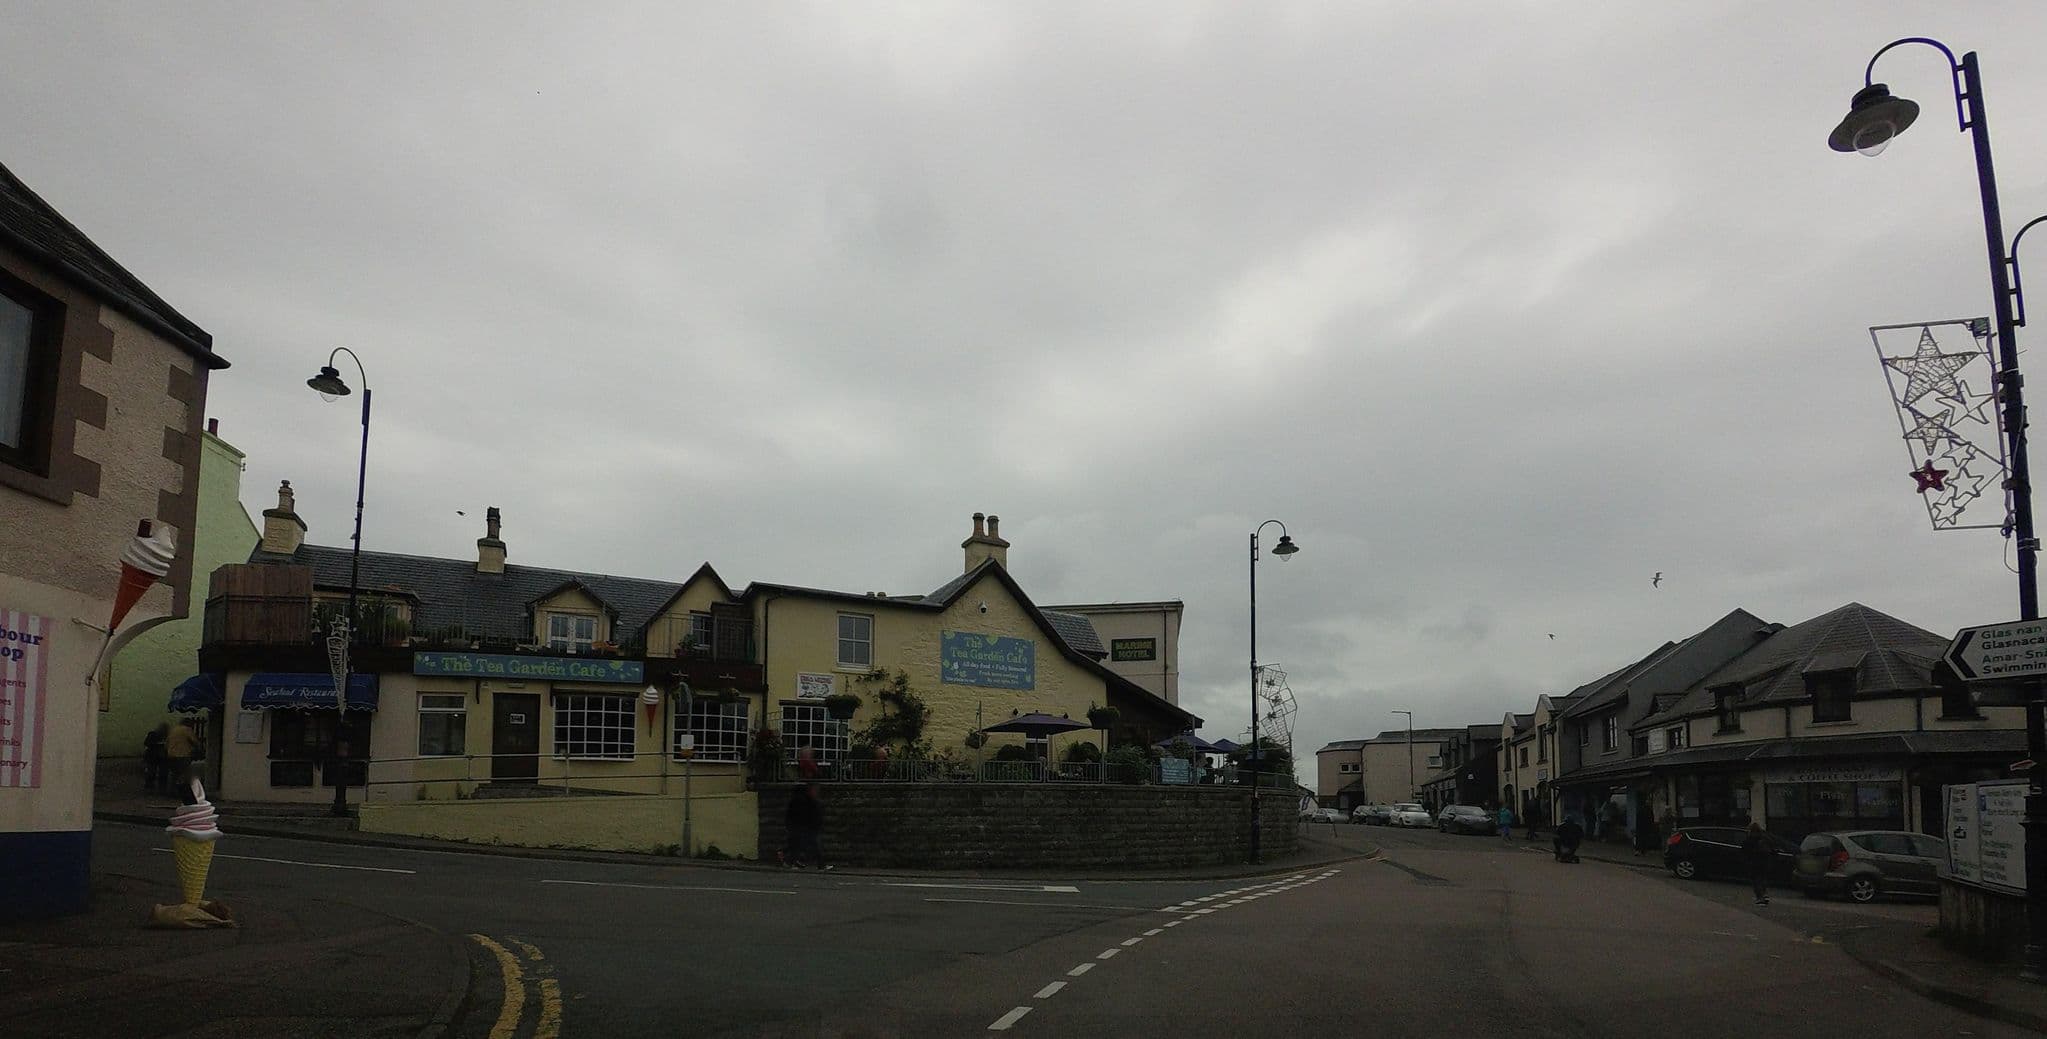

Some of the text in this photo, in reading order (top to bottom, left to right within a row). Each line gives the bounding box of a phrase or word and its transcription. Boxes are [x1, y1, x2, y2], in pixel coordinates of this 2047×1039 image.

[1981, 626, 2042, 640] Glas nan
[1981, 636, 2047, 650] Glasnaca
[951, 647, 968, 658] Tea
[970, 649, 1004, 662] Garden
[441, 656, 606, 678] The Tea Garden Cafe
[299, 687, 337, 699] Restaura
